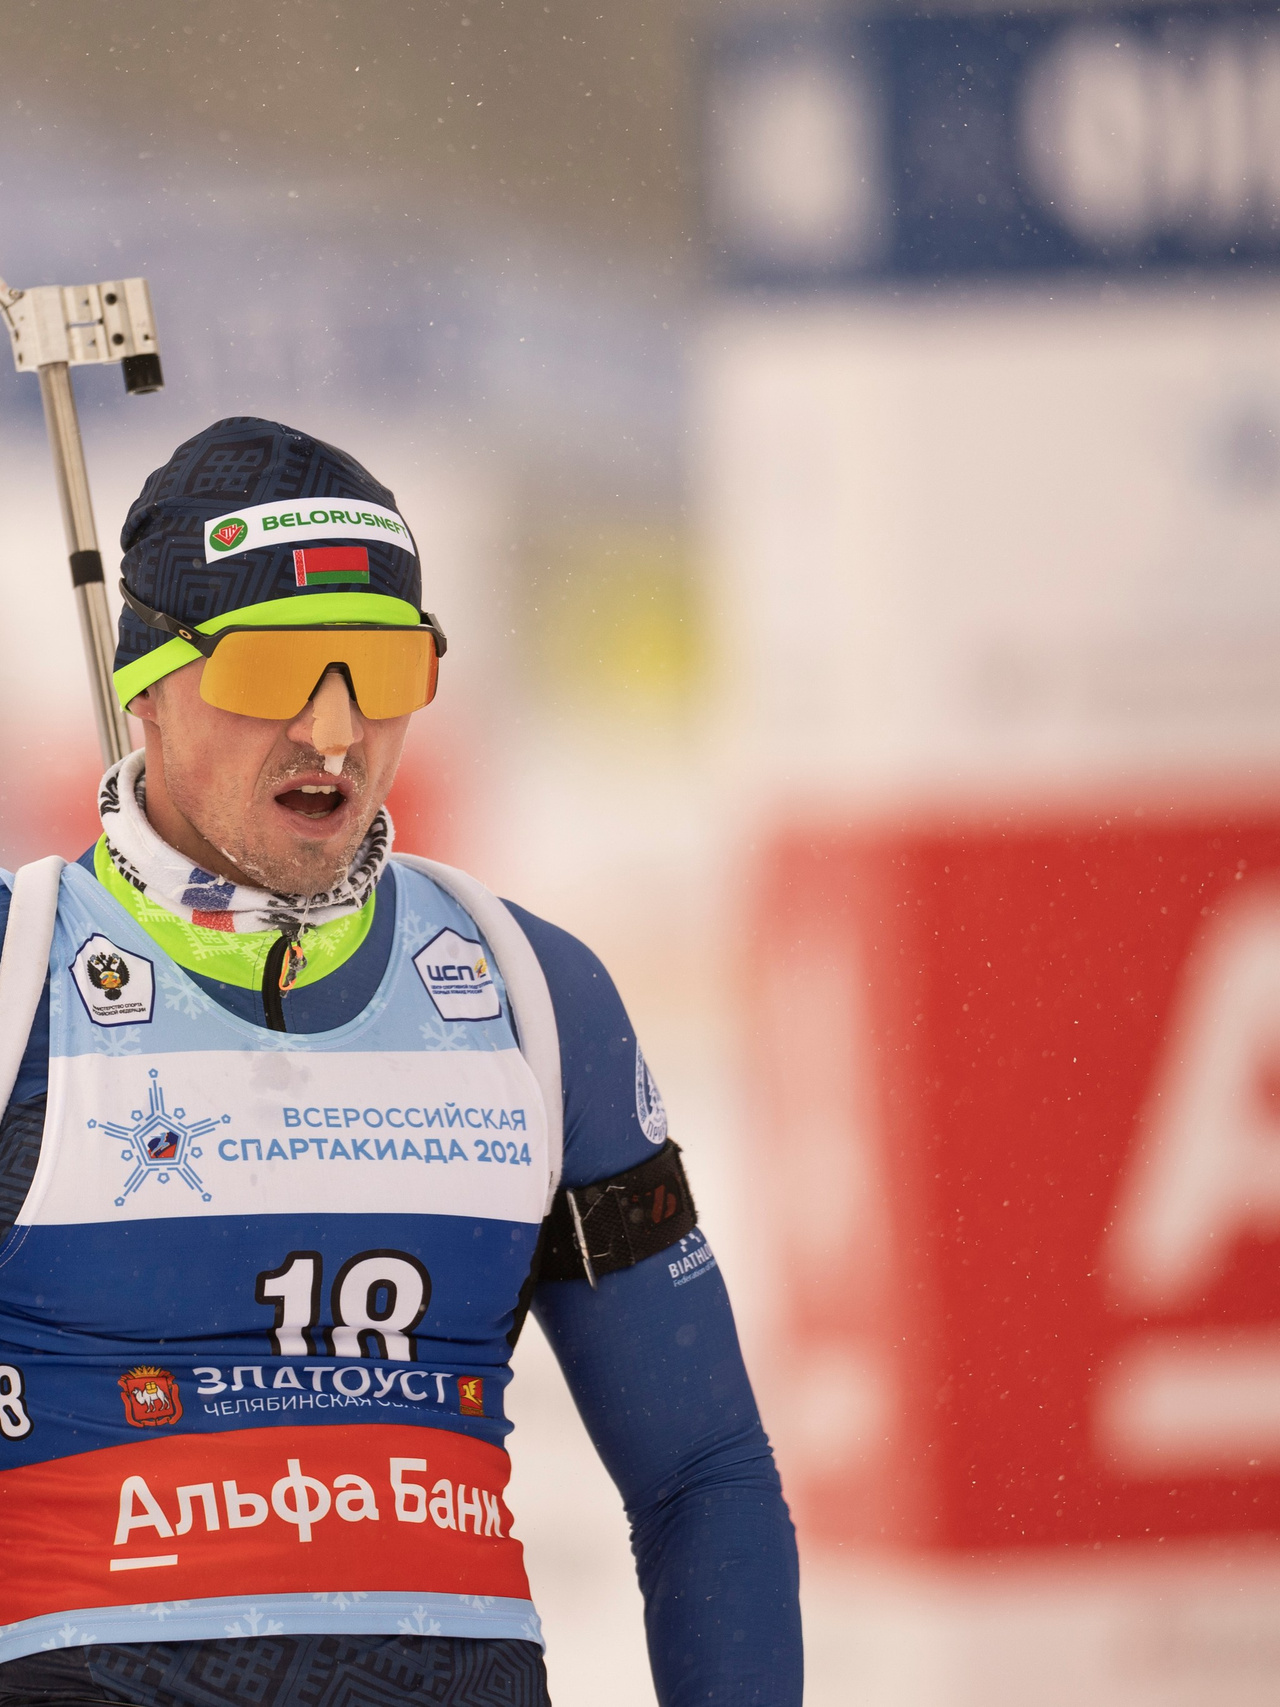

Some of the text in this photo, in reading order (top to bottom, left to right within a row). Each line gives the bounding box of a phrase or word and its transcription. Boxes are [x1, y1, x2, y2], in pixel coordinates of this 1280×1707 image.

[262, 510, 408, 539] BELORUSNEFT
[426, 964, 475, 981] ЦСП
[283, 1102, 527, 1132] ВСЕРОССИЙСКАЯ
[219, 1138, 532, 1167] СПАРТАКИАДА 2024
[256, 1250, 431, 1362] 18
[192, 1365, 453, 1404] ЗЛАТОУСТ
[113, 1457, 507, 1546] Альфа Банк
